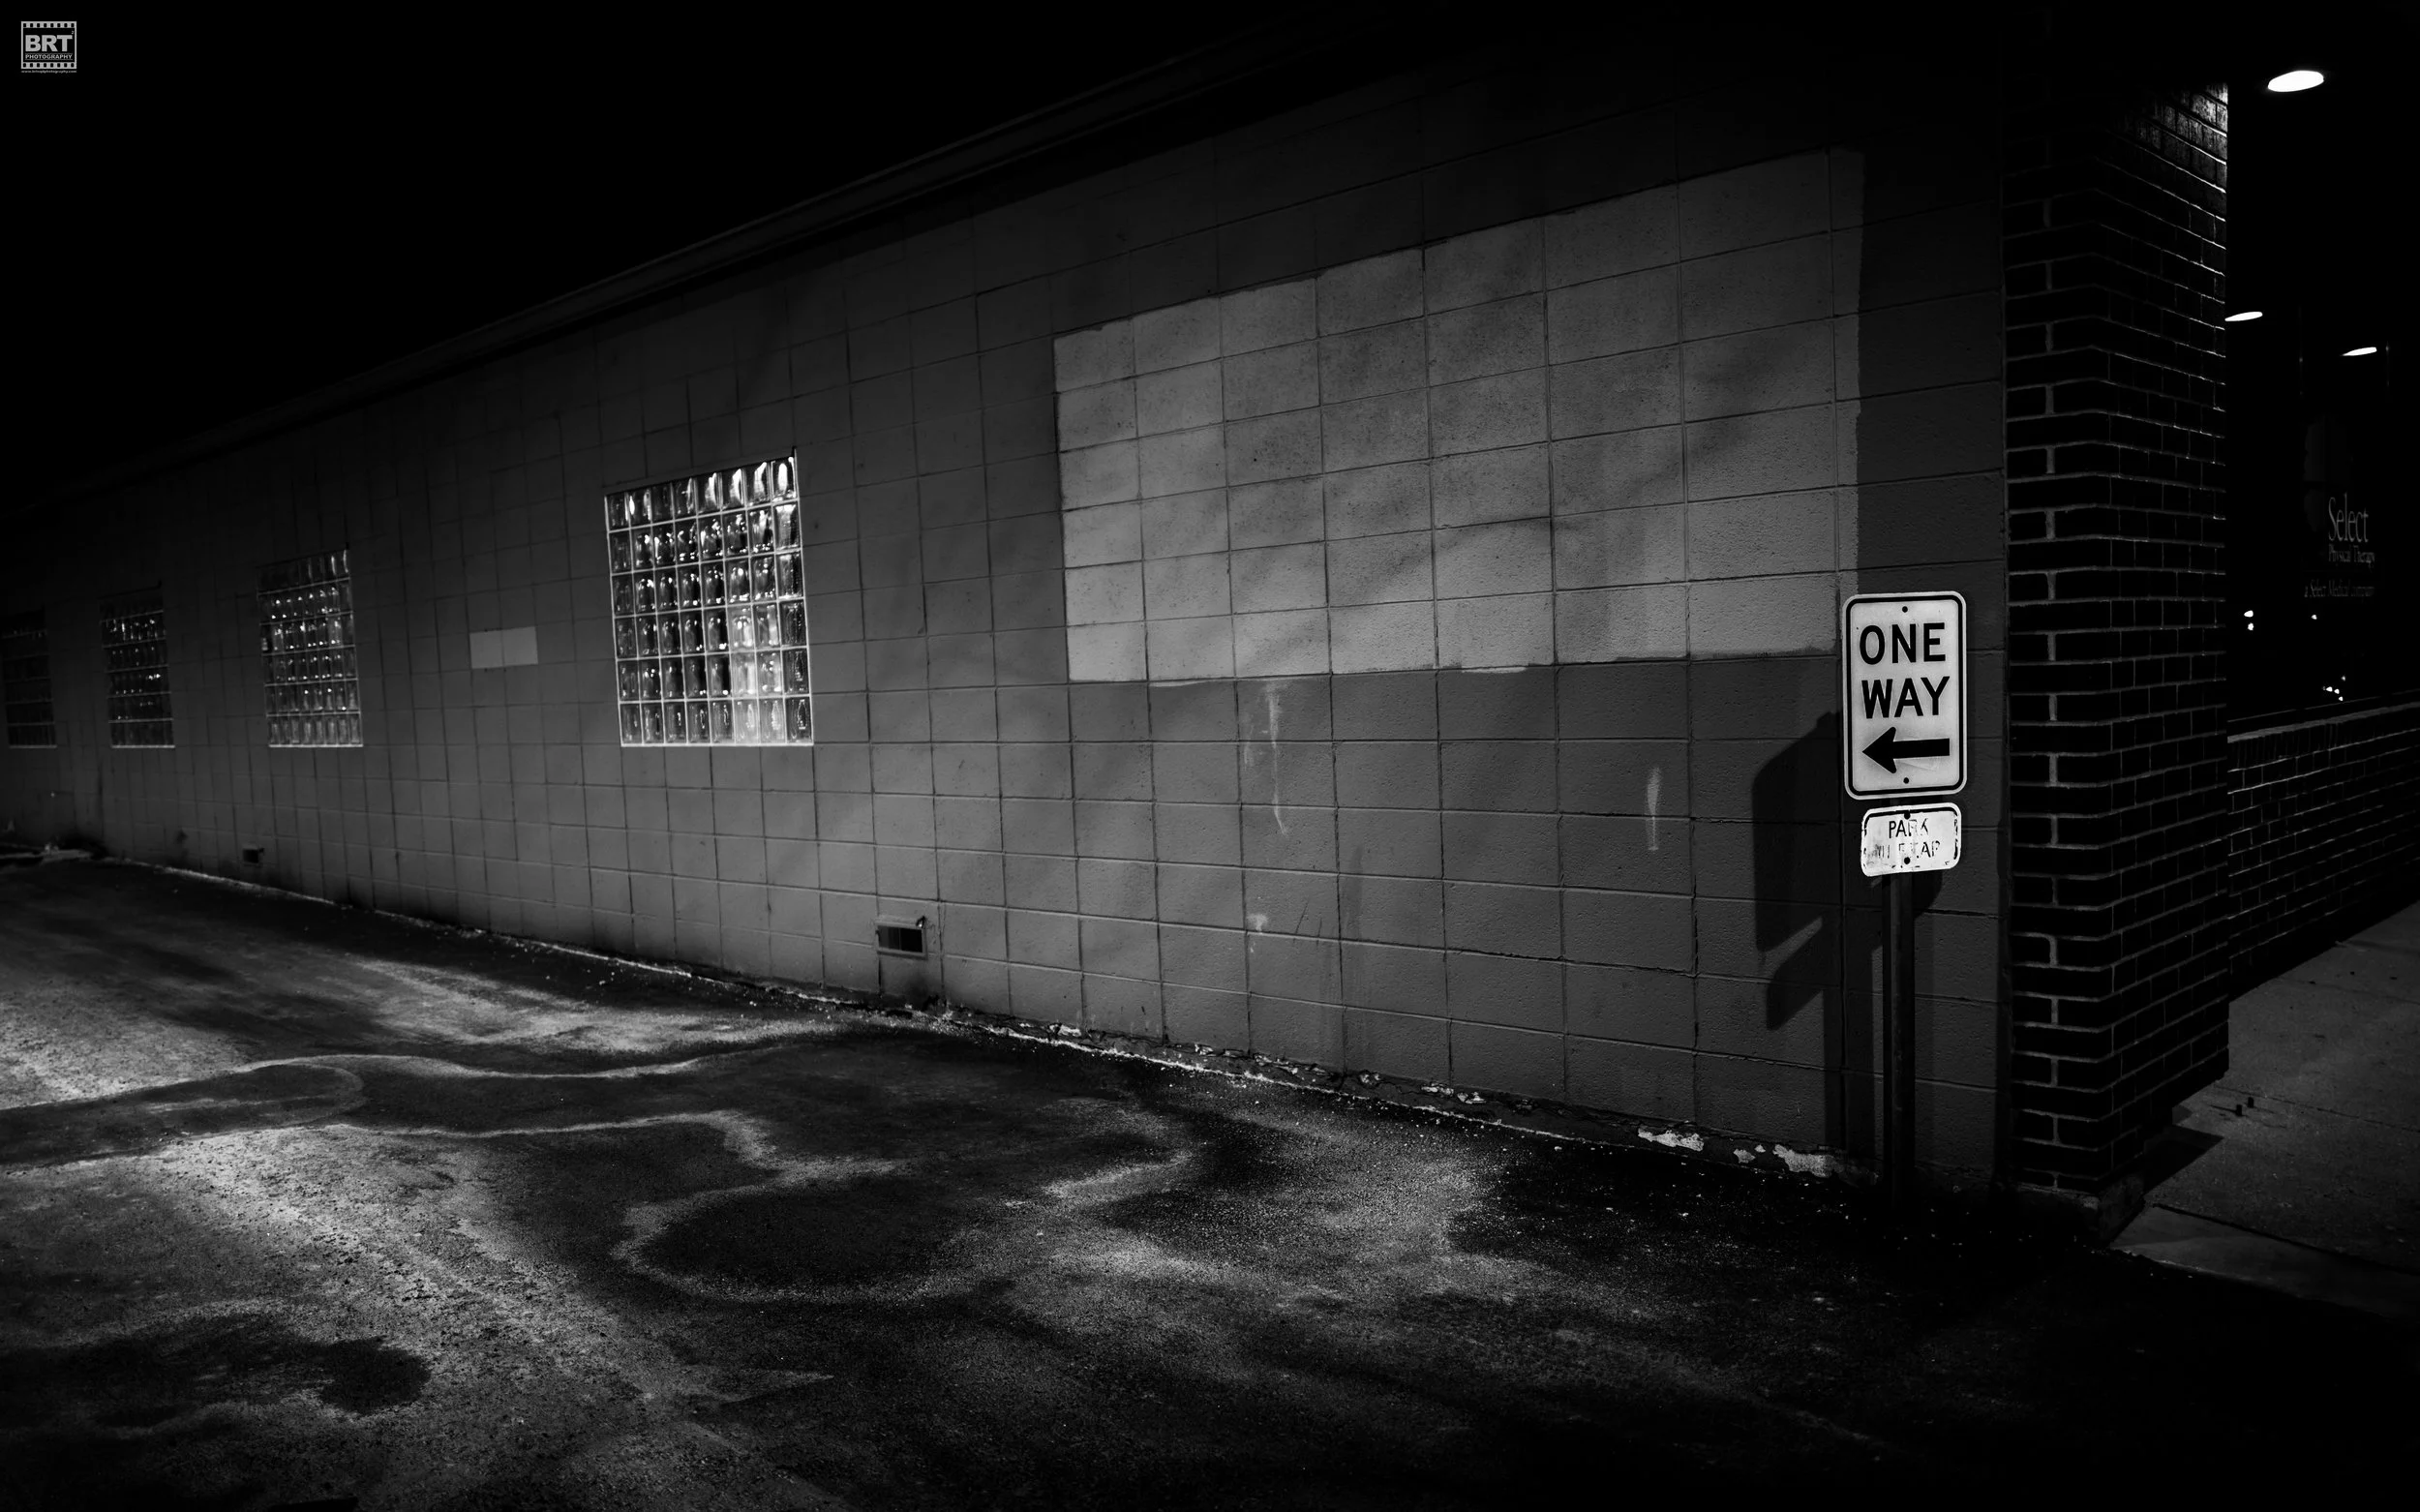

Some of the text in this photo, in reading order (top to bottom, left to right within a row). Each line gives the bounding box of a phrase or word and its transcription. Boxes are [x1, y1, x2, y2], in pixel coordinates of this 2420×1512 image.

[2328, 491, 2370, 543] Select
[2328, 543, 2375, 571] Physical Therapy
[1859, 622, 1946, 666] ONE
[1861, 676, 1951, 719] WAY
[1889, 818, 1929, 839] PARK
